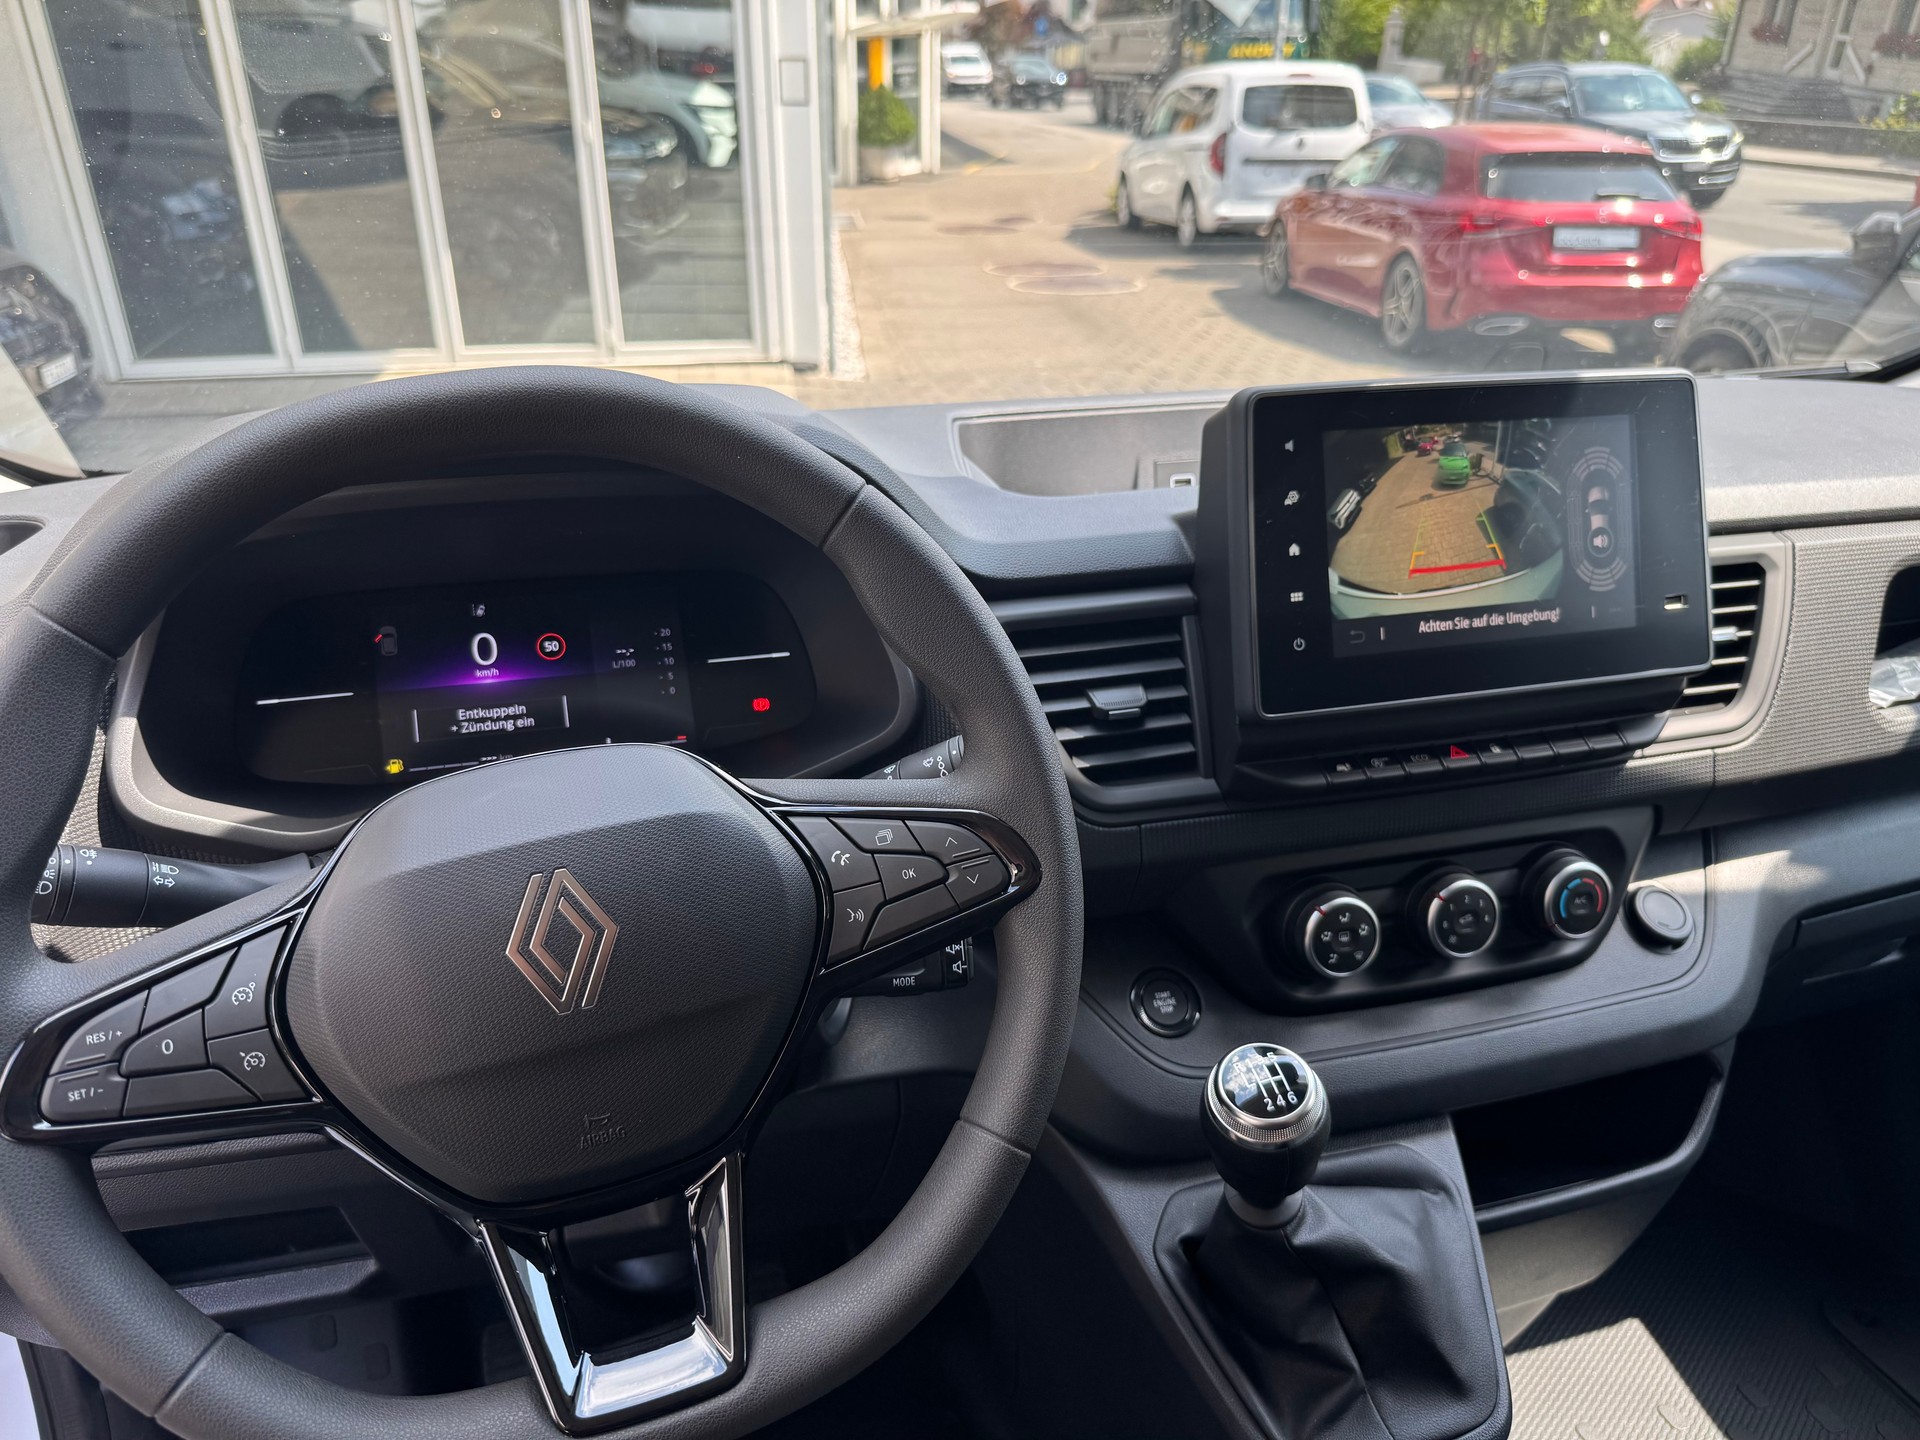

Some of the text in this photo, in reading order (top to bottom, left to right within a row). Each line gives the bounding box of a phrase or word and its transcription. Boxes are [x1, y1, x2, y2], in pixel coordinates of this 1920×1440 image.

[1419, 608, 1560, 633] Achten Sie auf die Umgebung!
[660, 628, 671, 637] 20
[471, 632, 498, 666] 0
[543, 640, 560, 653] 50
[662, 642, 673, 651] 15
[612, 659, 636, 669] L/100
[664, 657, 675, 666] 10
[474, 668, 499, 678] km/h
[667, 672, 674, 681] 5
[669, 686, 676, 695] 0
[457, 704, 527, 721] Entkuppeln
[461, 718, 515, 734] Zündung
[517, 716, 535, 728] ein
[902, 868, 916, 880] OK
[892, 976, 916, 987] MODE
[86, 1032, 107, 1045] RES
[68, 1088, 88, 1102] SET
[1264, 1091, 1299, 1112] 2 4 6
[580, 1125, 627, 1149] AIRBAG
